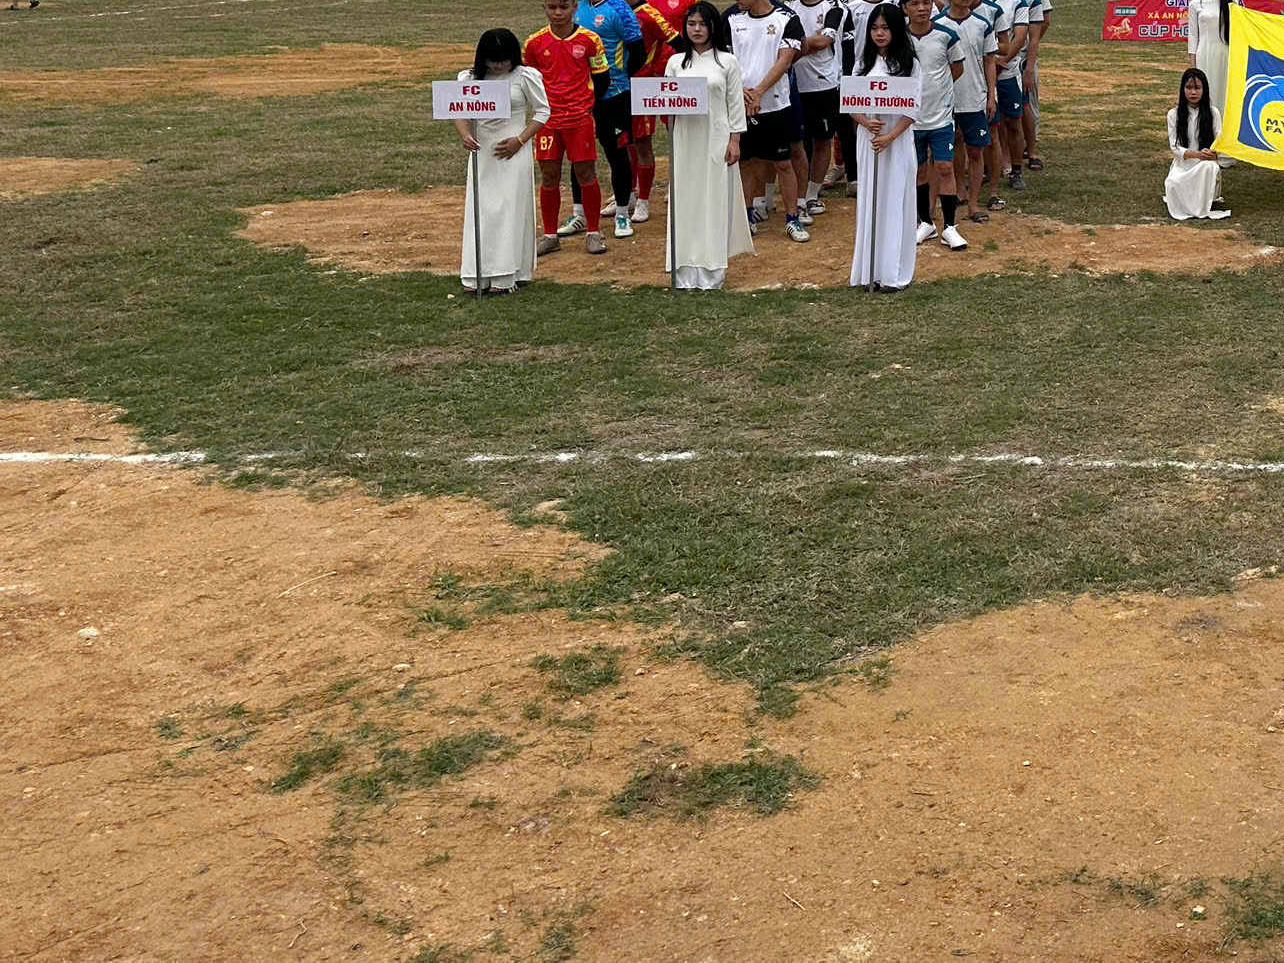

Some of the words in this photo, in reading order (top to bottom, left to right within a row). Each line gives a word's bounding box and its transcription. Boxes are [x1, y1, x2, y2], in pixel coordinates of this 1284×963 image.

[1176, 11, 1189, 19] NÔ
[1139, 21, 1170, 37] CÚP
[462, 85, 480, 95] FC
[660, 81, 678, 91] FC
[870, 81, 888, 91] FC
[449, 101, 464, 112] AN
[466, 100, 496, 112] NÔNG
[642, 95, 665, 108] TIẾN
[668, 96, 697, 108] NÔNG
[842, 95, 871, 107] NÔNG
[874, 95, 915, 108] TRƯỜNG
[540, 135, 554, 151] 87
